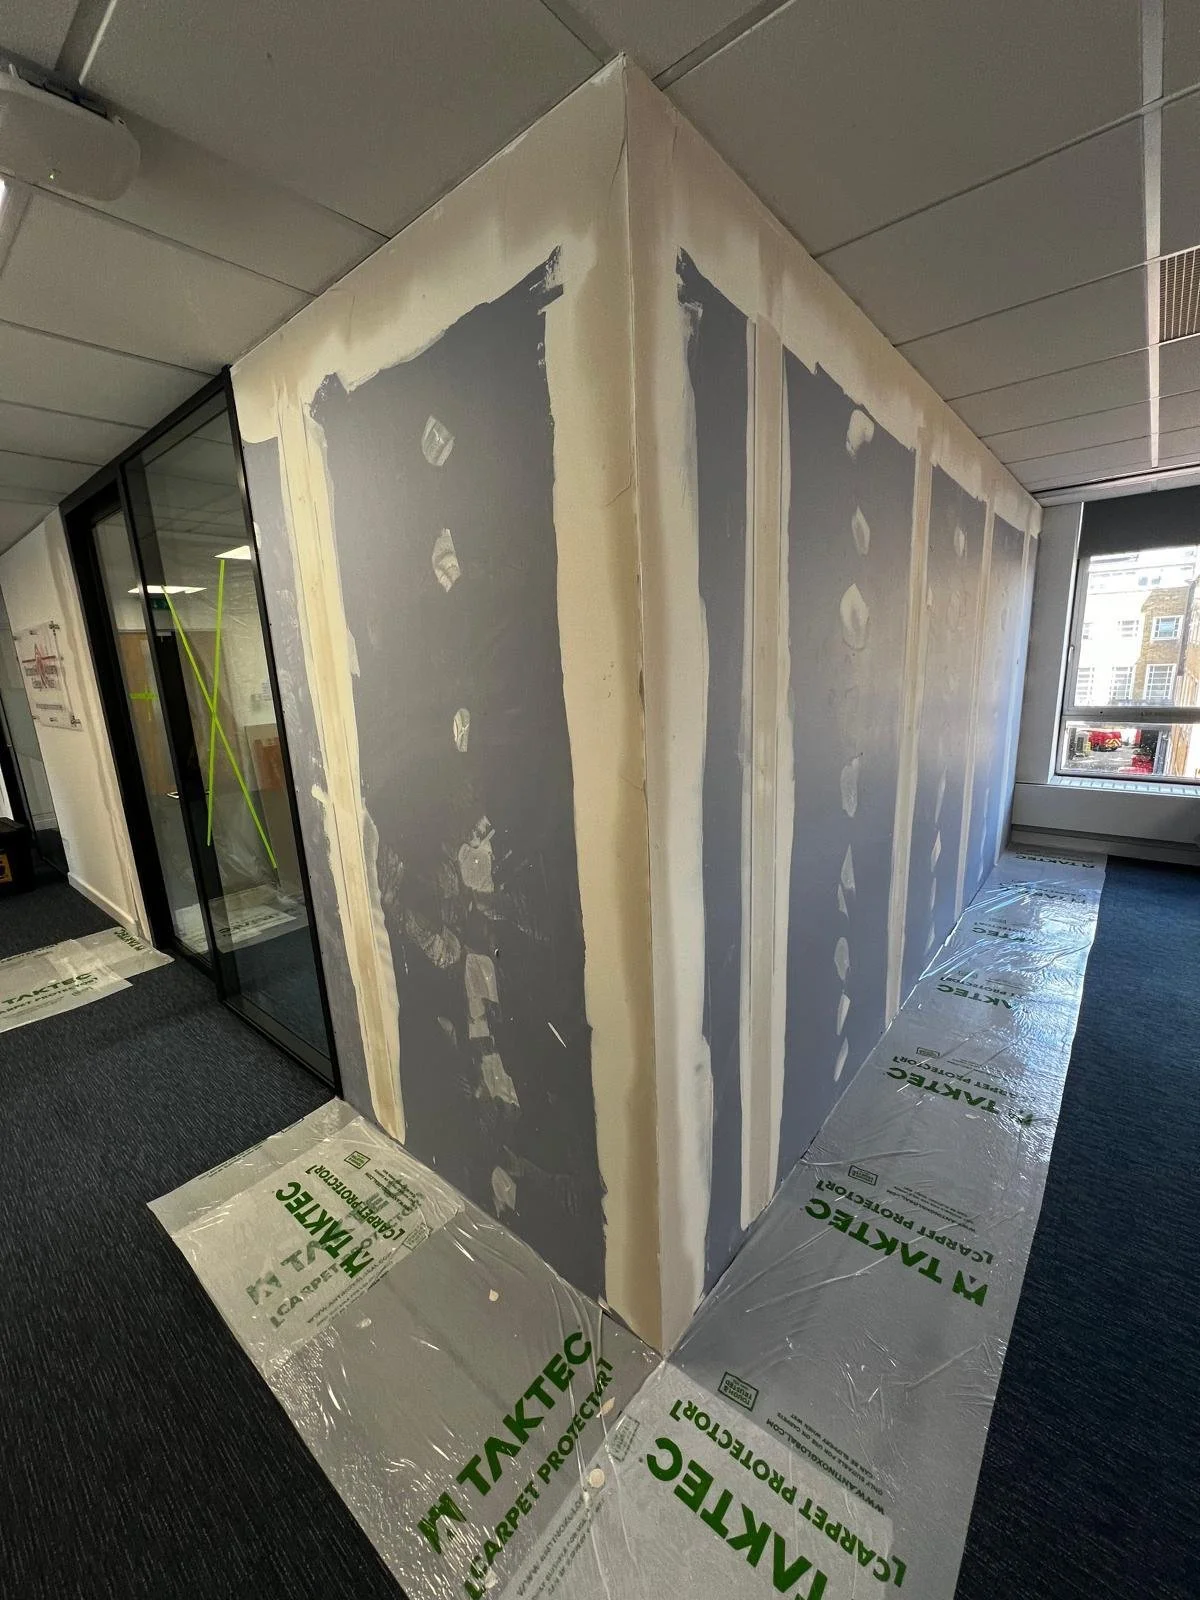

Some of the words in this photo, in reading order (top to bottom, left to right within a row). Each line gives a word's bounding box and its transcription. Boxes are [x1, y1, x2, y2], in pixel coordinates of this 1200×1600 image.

[2, 972, 91, 1004] TAKTEC
[885, 1067, 998, 1114] TAKTEC
[276, 1183, 353, 1259] TAKTEC
[314, 1164, 362, 1209] PROTECTOR
[356, 1203, 395, 1240] CARPET
[824, 1180, 914, 1229] PROTECTOR
[804, 1200, 940, 1283] TAKTEC
[916, 1225, 984, 1263] CARPET
[455, 1330, 594, 1495] TAKTEC
[468, 1480, 542, 1581] CARPET
[537, 1371, 613, 1484] PROTECTOR
[682, 1399, 797, 1505] PROTECTOR
[646, 1437, 828, 1600] TAKTEC
[797, 1497, 893, 1583] CARPET
